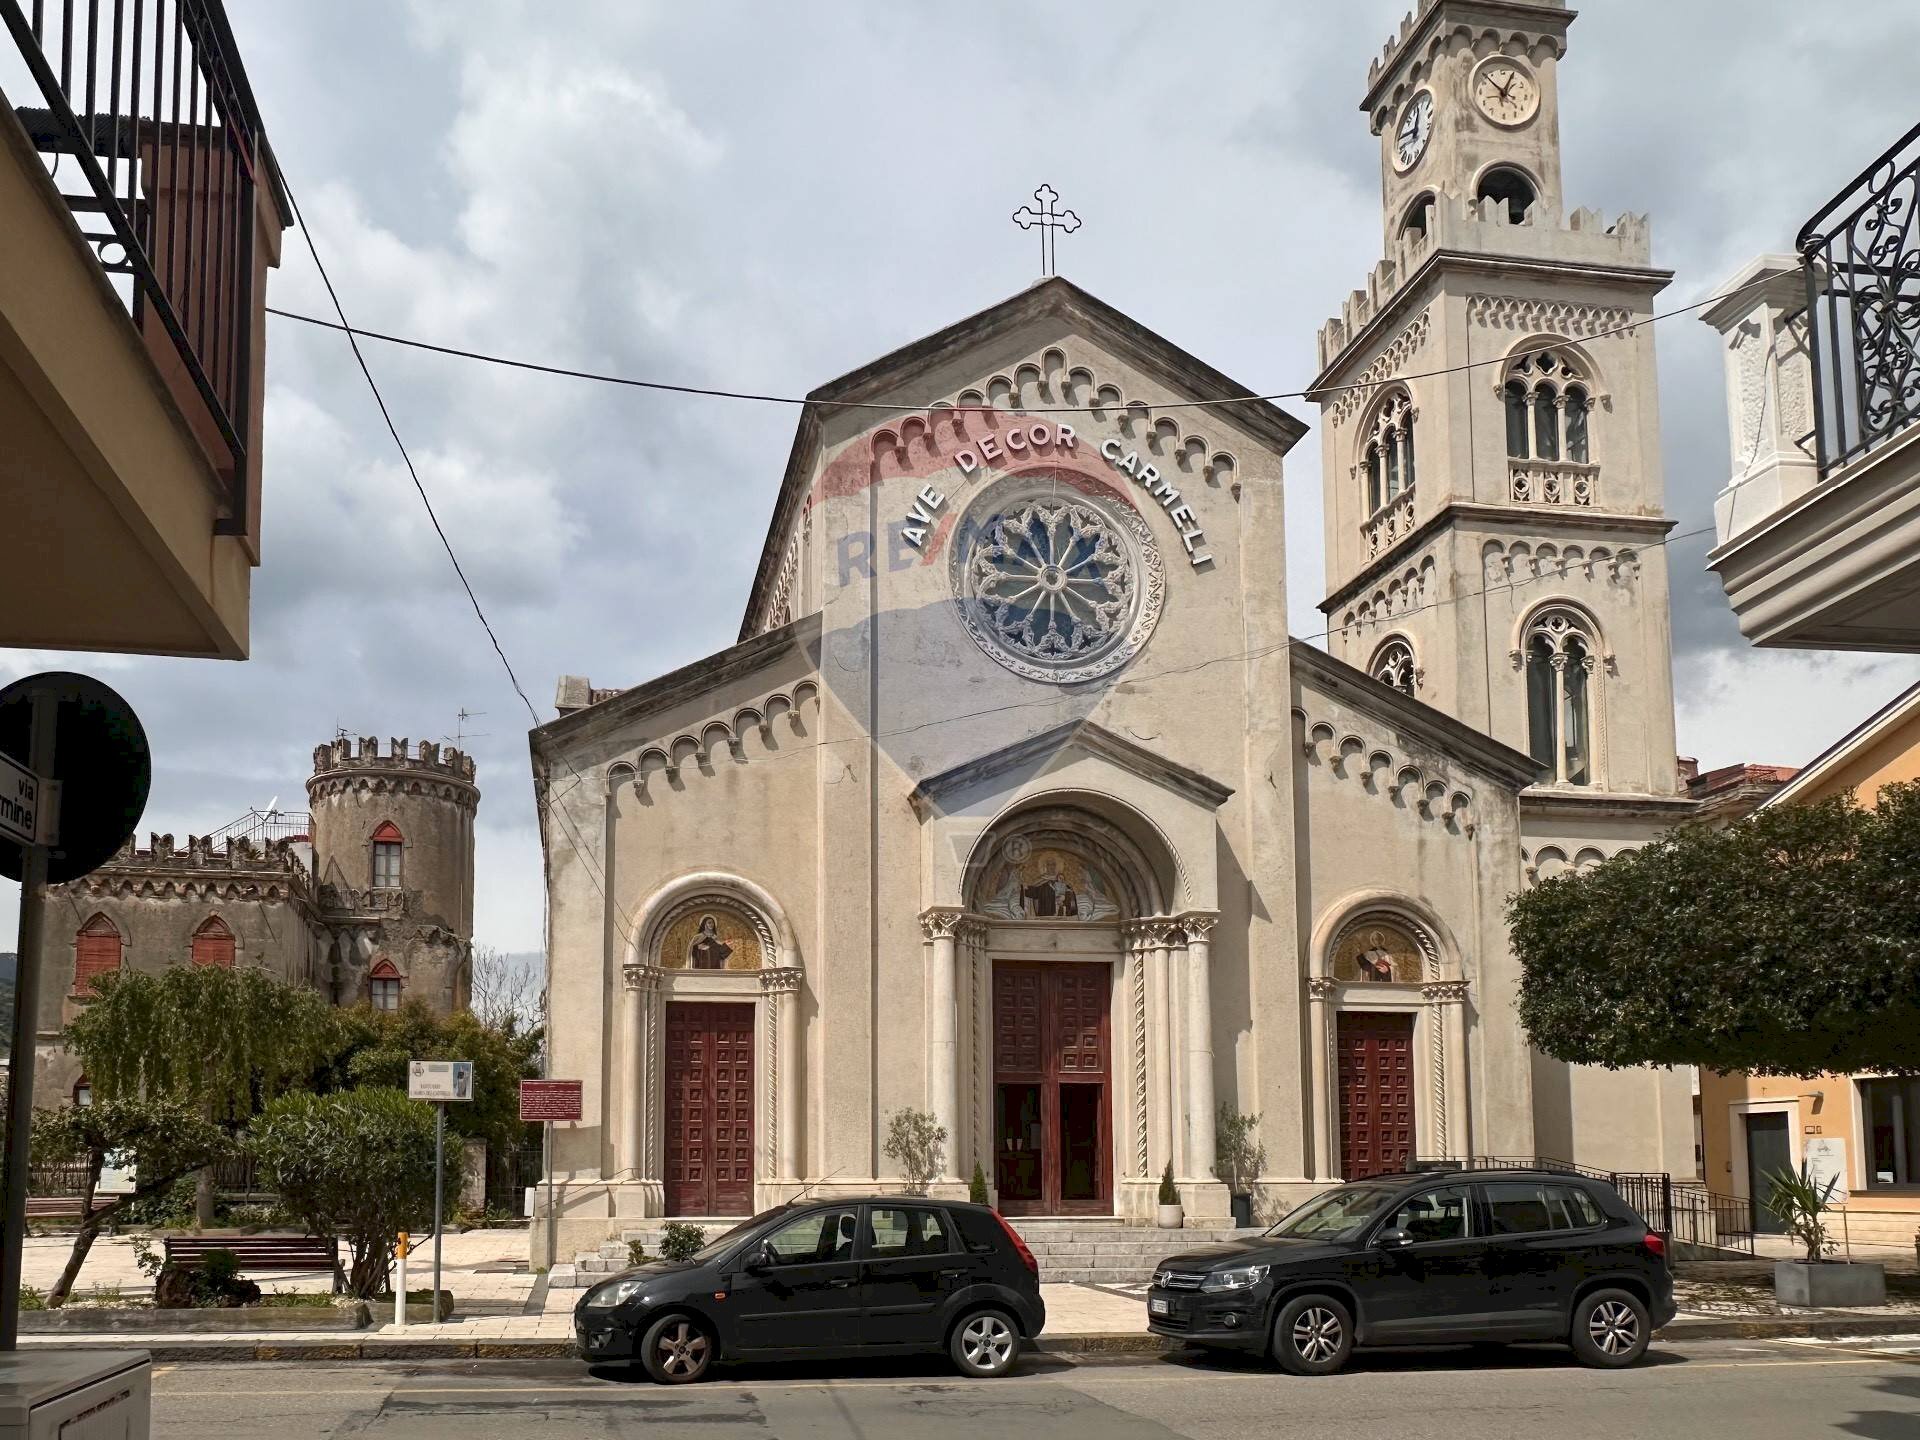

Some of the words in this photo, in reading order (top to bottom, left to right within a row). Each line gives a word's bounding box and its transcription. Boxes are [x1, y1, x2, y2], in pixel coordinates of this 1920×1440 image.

[901, 483, 945, 547] AVE
[953, 423, 1076, 473] DECOR
[1101, 439, 1212, 565] CARMELI
[18, 778, 34, 802] via
